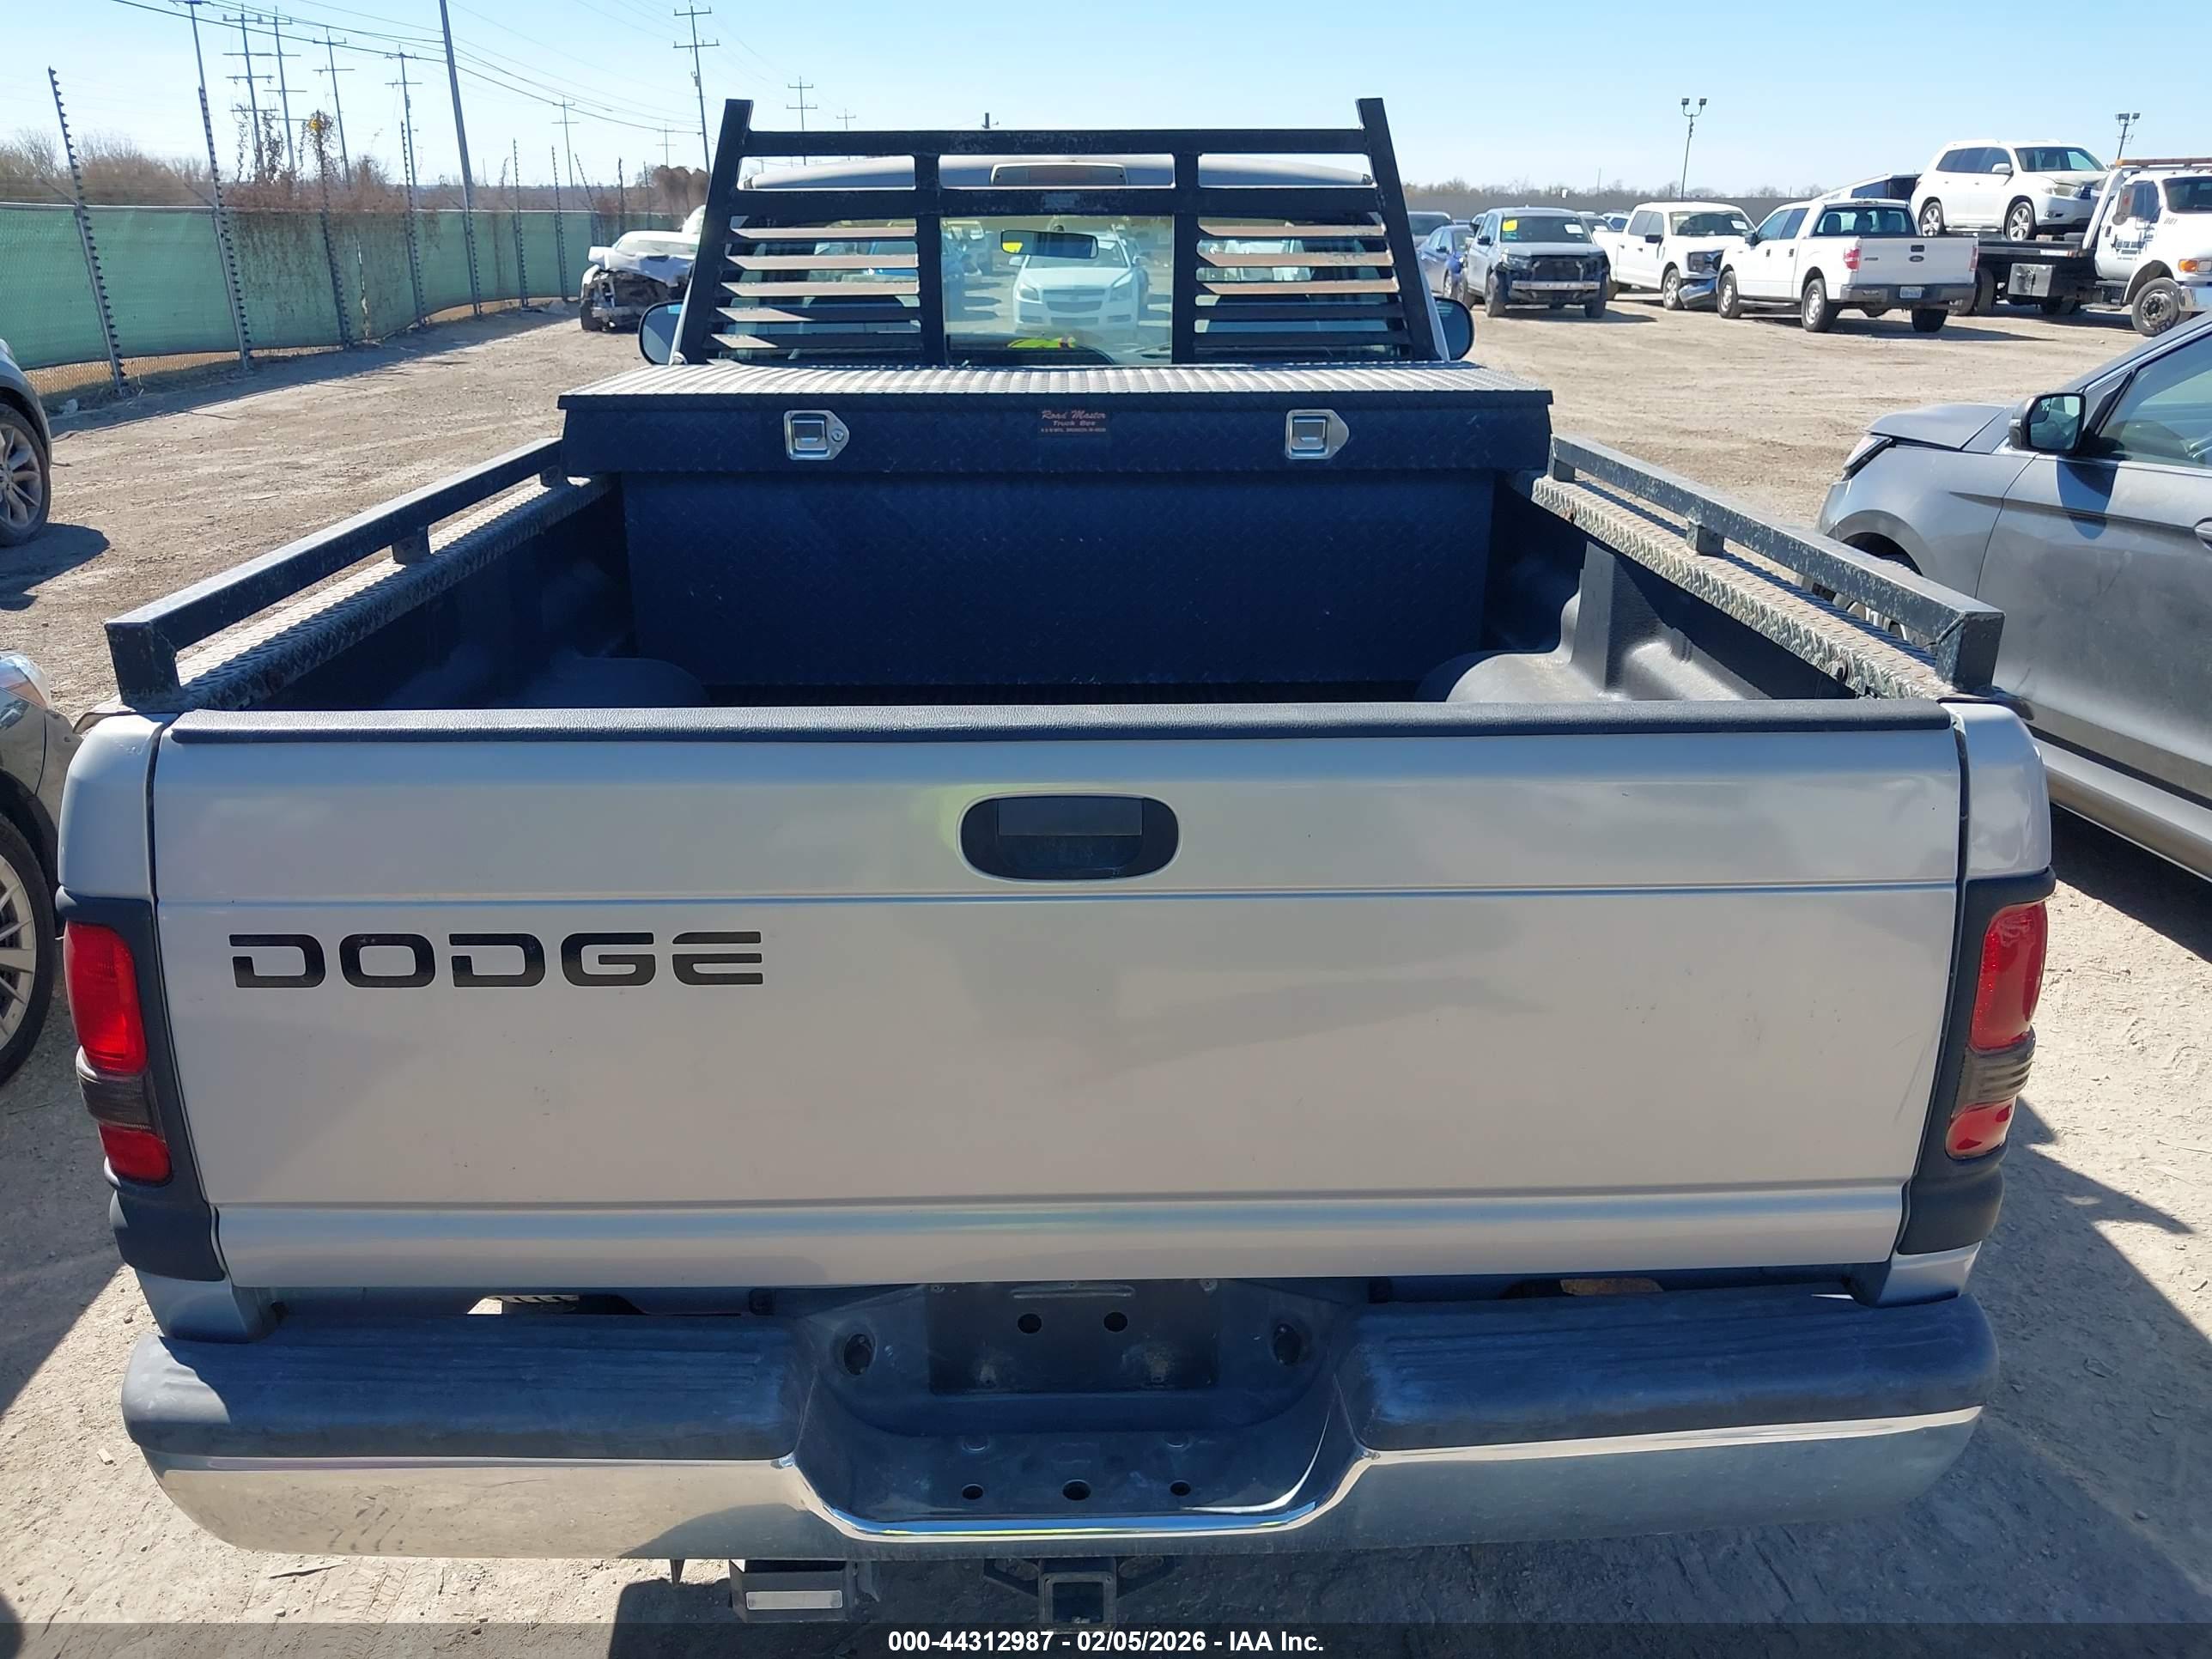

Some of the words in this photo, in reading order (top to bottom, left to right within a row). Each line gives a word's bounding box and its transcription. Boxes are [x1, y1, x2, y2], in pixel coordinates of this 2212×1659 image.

[1041, 410, 1067, 420] Road
[1071, 410, 1107, 420] Master
[229, 932, 763, 988] DODGE
